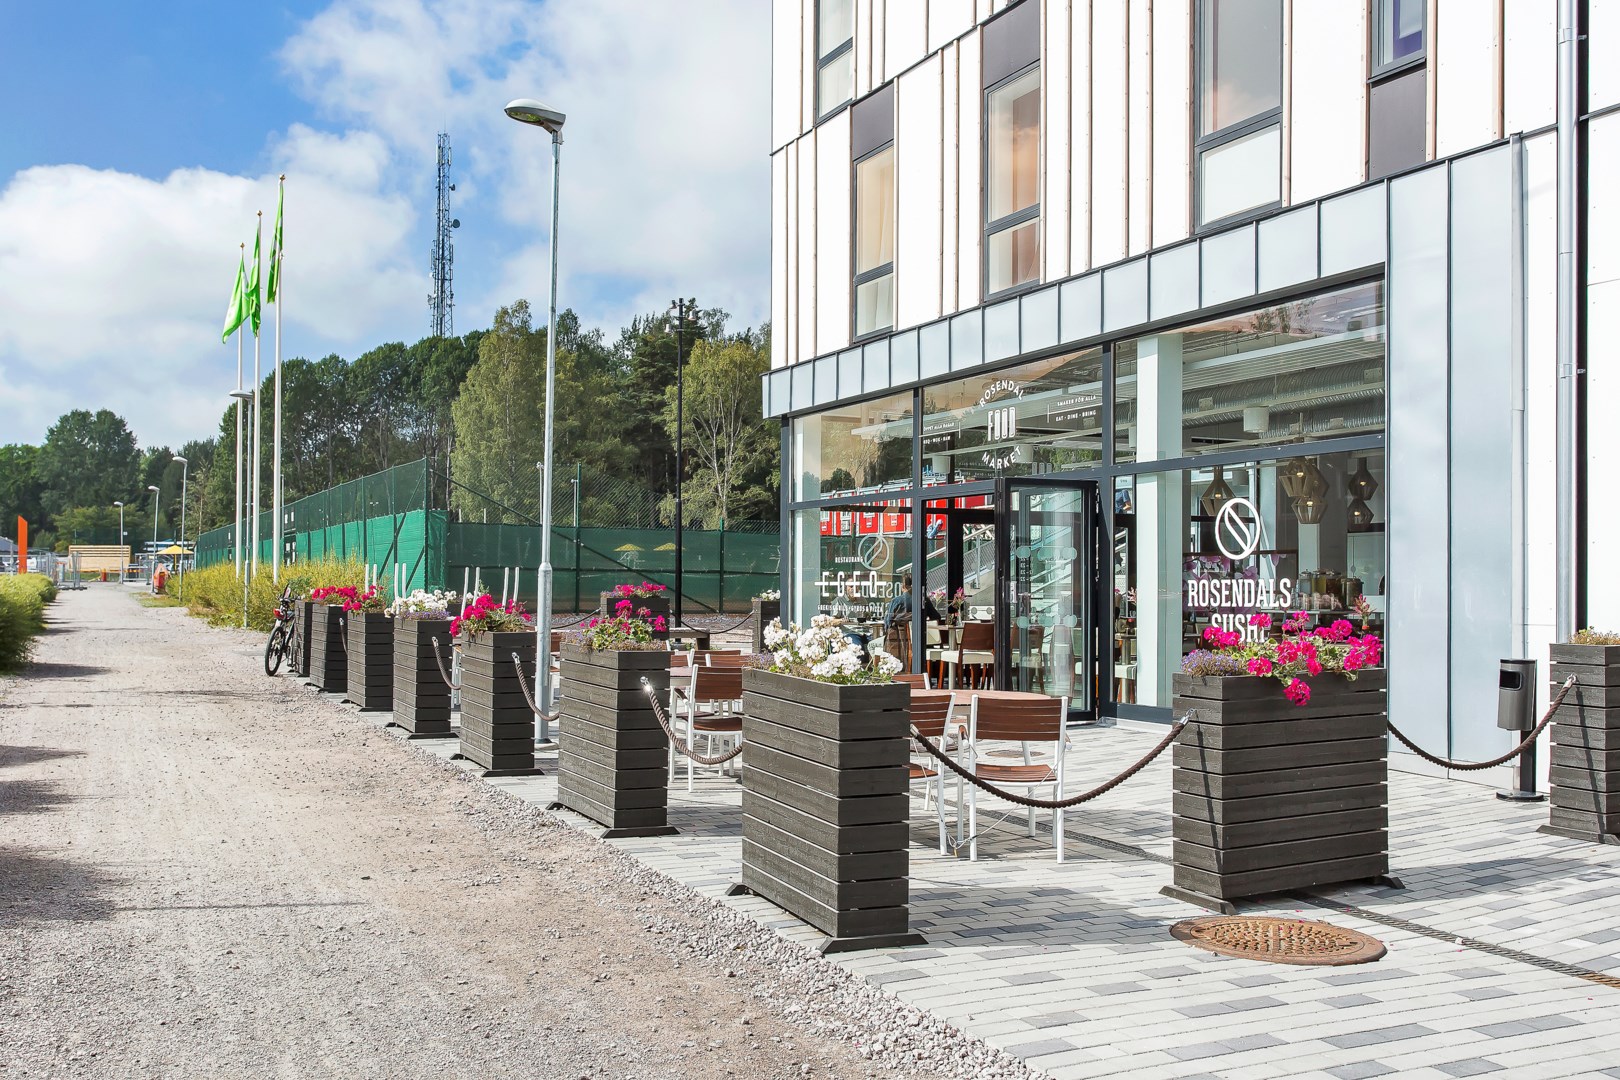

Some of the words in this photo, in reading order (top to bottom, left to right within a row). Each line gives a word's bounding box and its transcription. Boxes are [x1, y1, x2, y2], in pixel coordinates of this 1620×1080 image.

[980, 380, 1024, 407] ROSENDAL
[988, 407, 1016, 441] FOOD
[981, 445, 1021, 469] MARKET
[815, 571, 886, 597] EGEO
[1187, 578, 1292, 608] ROSENDALS
